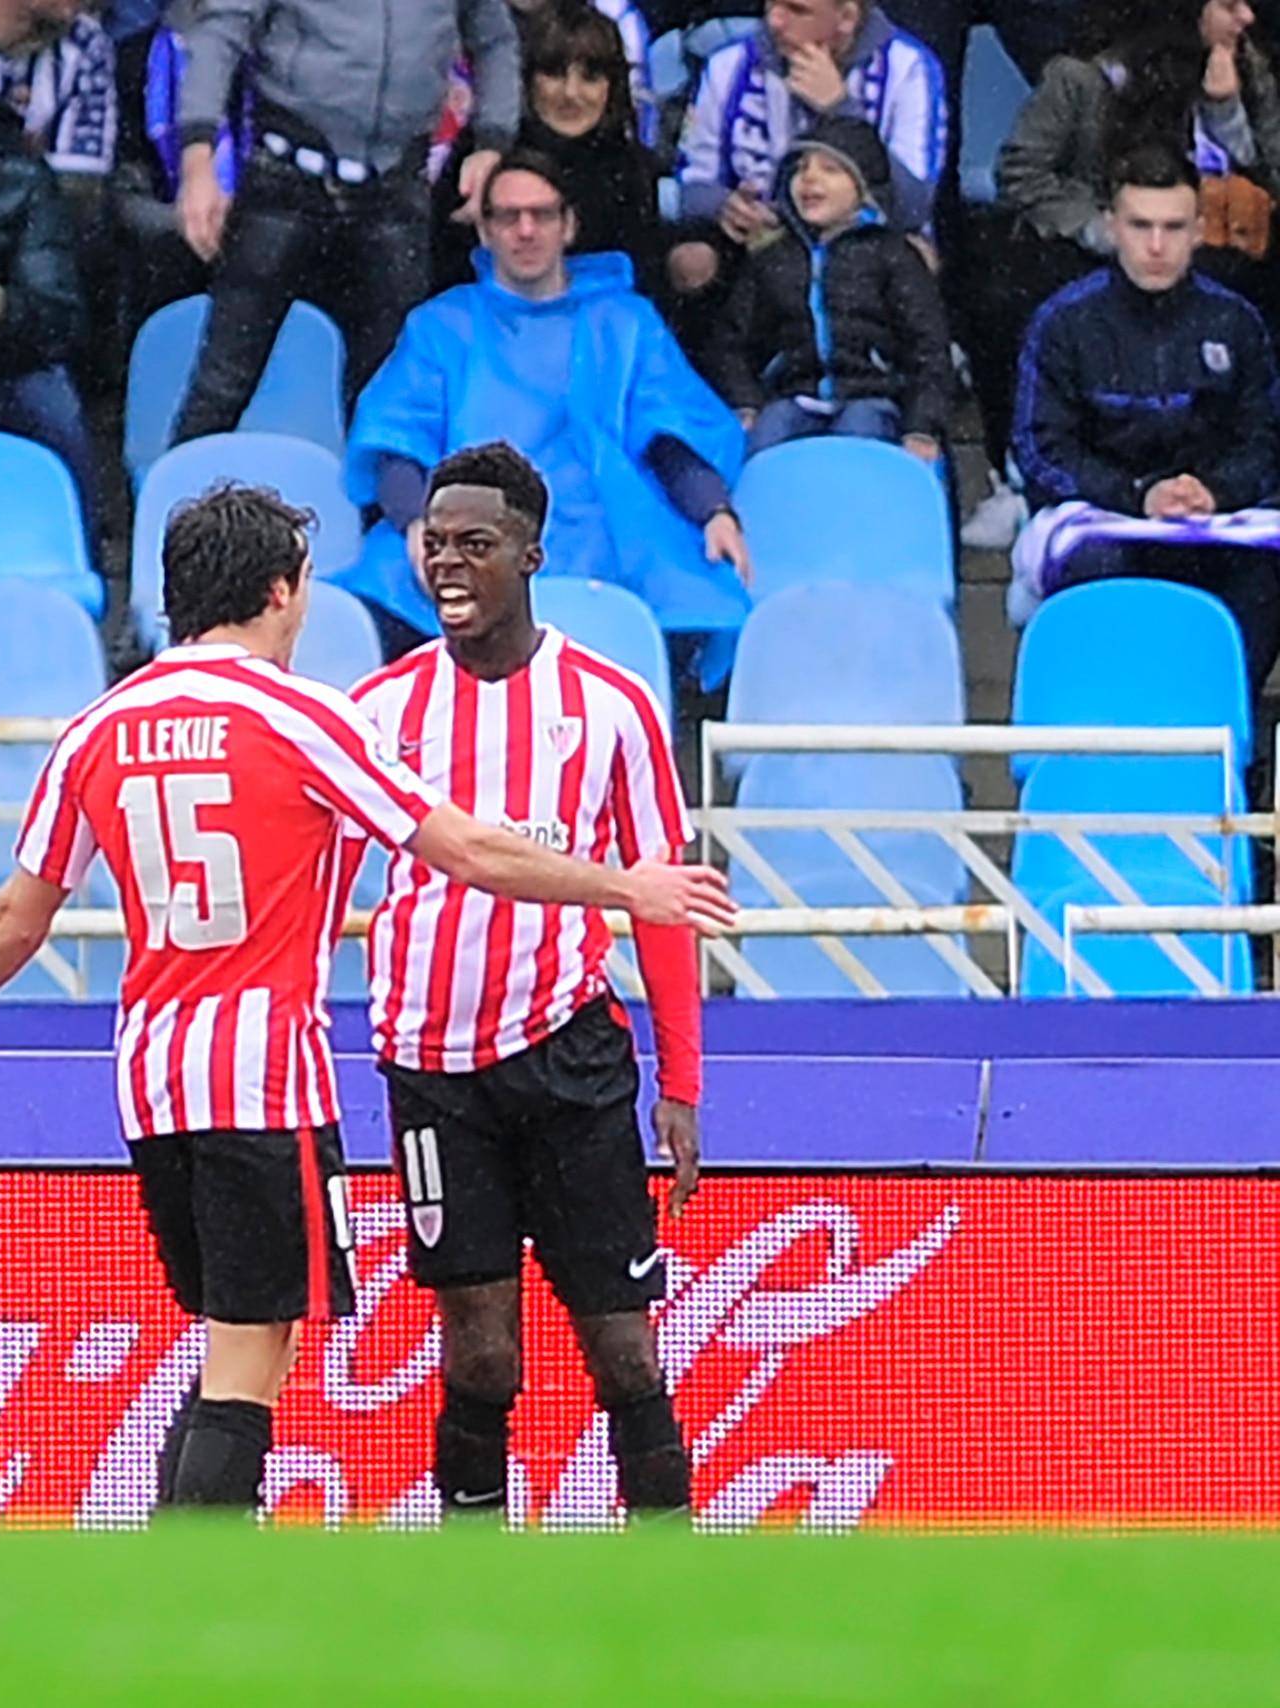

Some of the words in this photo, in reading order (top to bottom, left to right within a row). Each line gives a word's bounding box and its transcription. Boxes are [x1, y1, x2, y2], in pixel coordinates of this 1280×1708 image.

[138, 716, 230, 763] LEKUE
[116, 772, 249, 951] 15
[403, 1126, 443, 1202] 11
